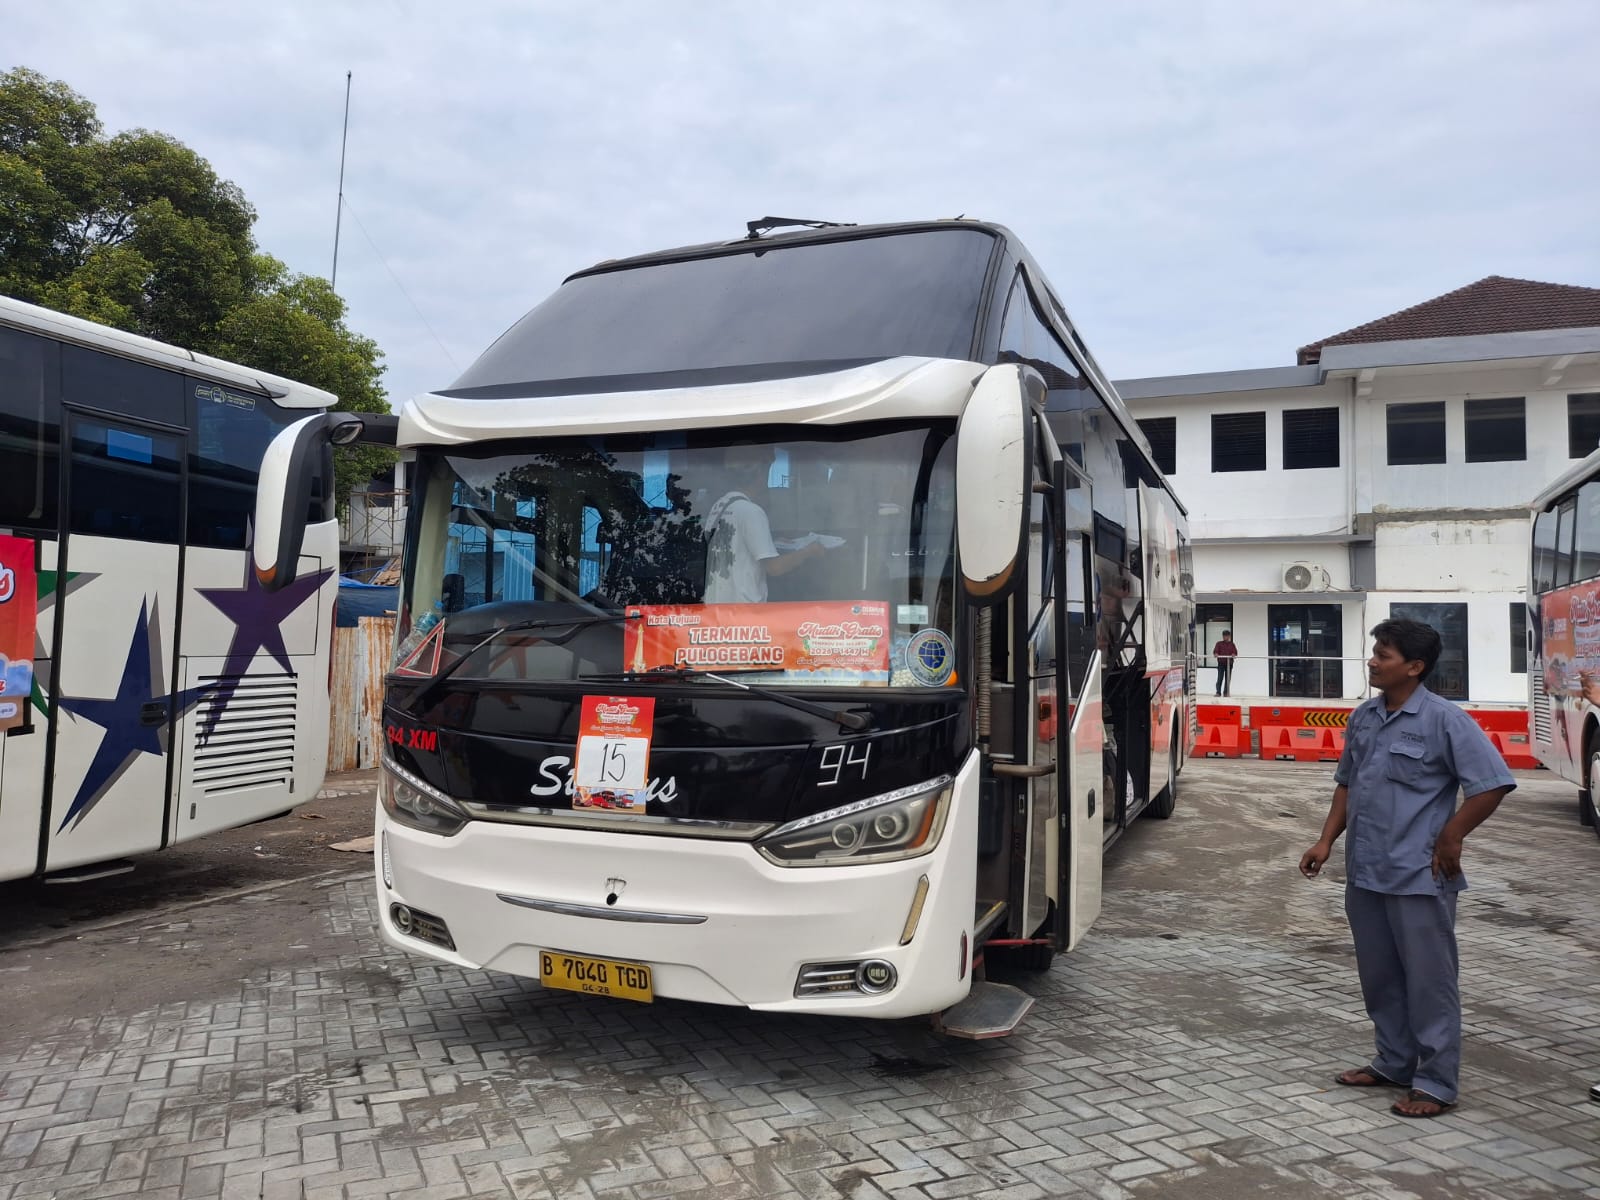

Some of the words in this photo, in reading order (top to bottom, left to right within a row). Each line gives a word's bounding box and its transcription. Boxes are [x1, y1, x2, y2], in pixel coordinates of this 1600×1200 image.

[648, 615, 669, 625] Kota
[669, 615, 700, 626] Tujuan
[689, 626, 771, 644] TERMINAL
[798, 621, 840, 639] Mudik
[841, 621, 883, 640] Gratis
[675, 646, 784, 665] PULOGEBANG
[810, 647, 832, 656] 2026
[408, 728, 437, 752] XM
[598, 743, 627, 782] 15
[817, 742, 872, 787] 94
[543, 955, 553, 976] B
[562, 959, 607, 983] 7040
[615, 965, 648, 990] TGD
